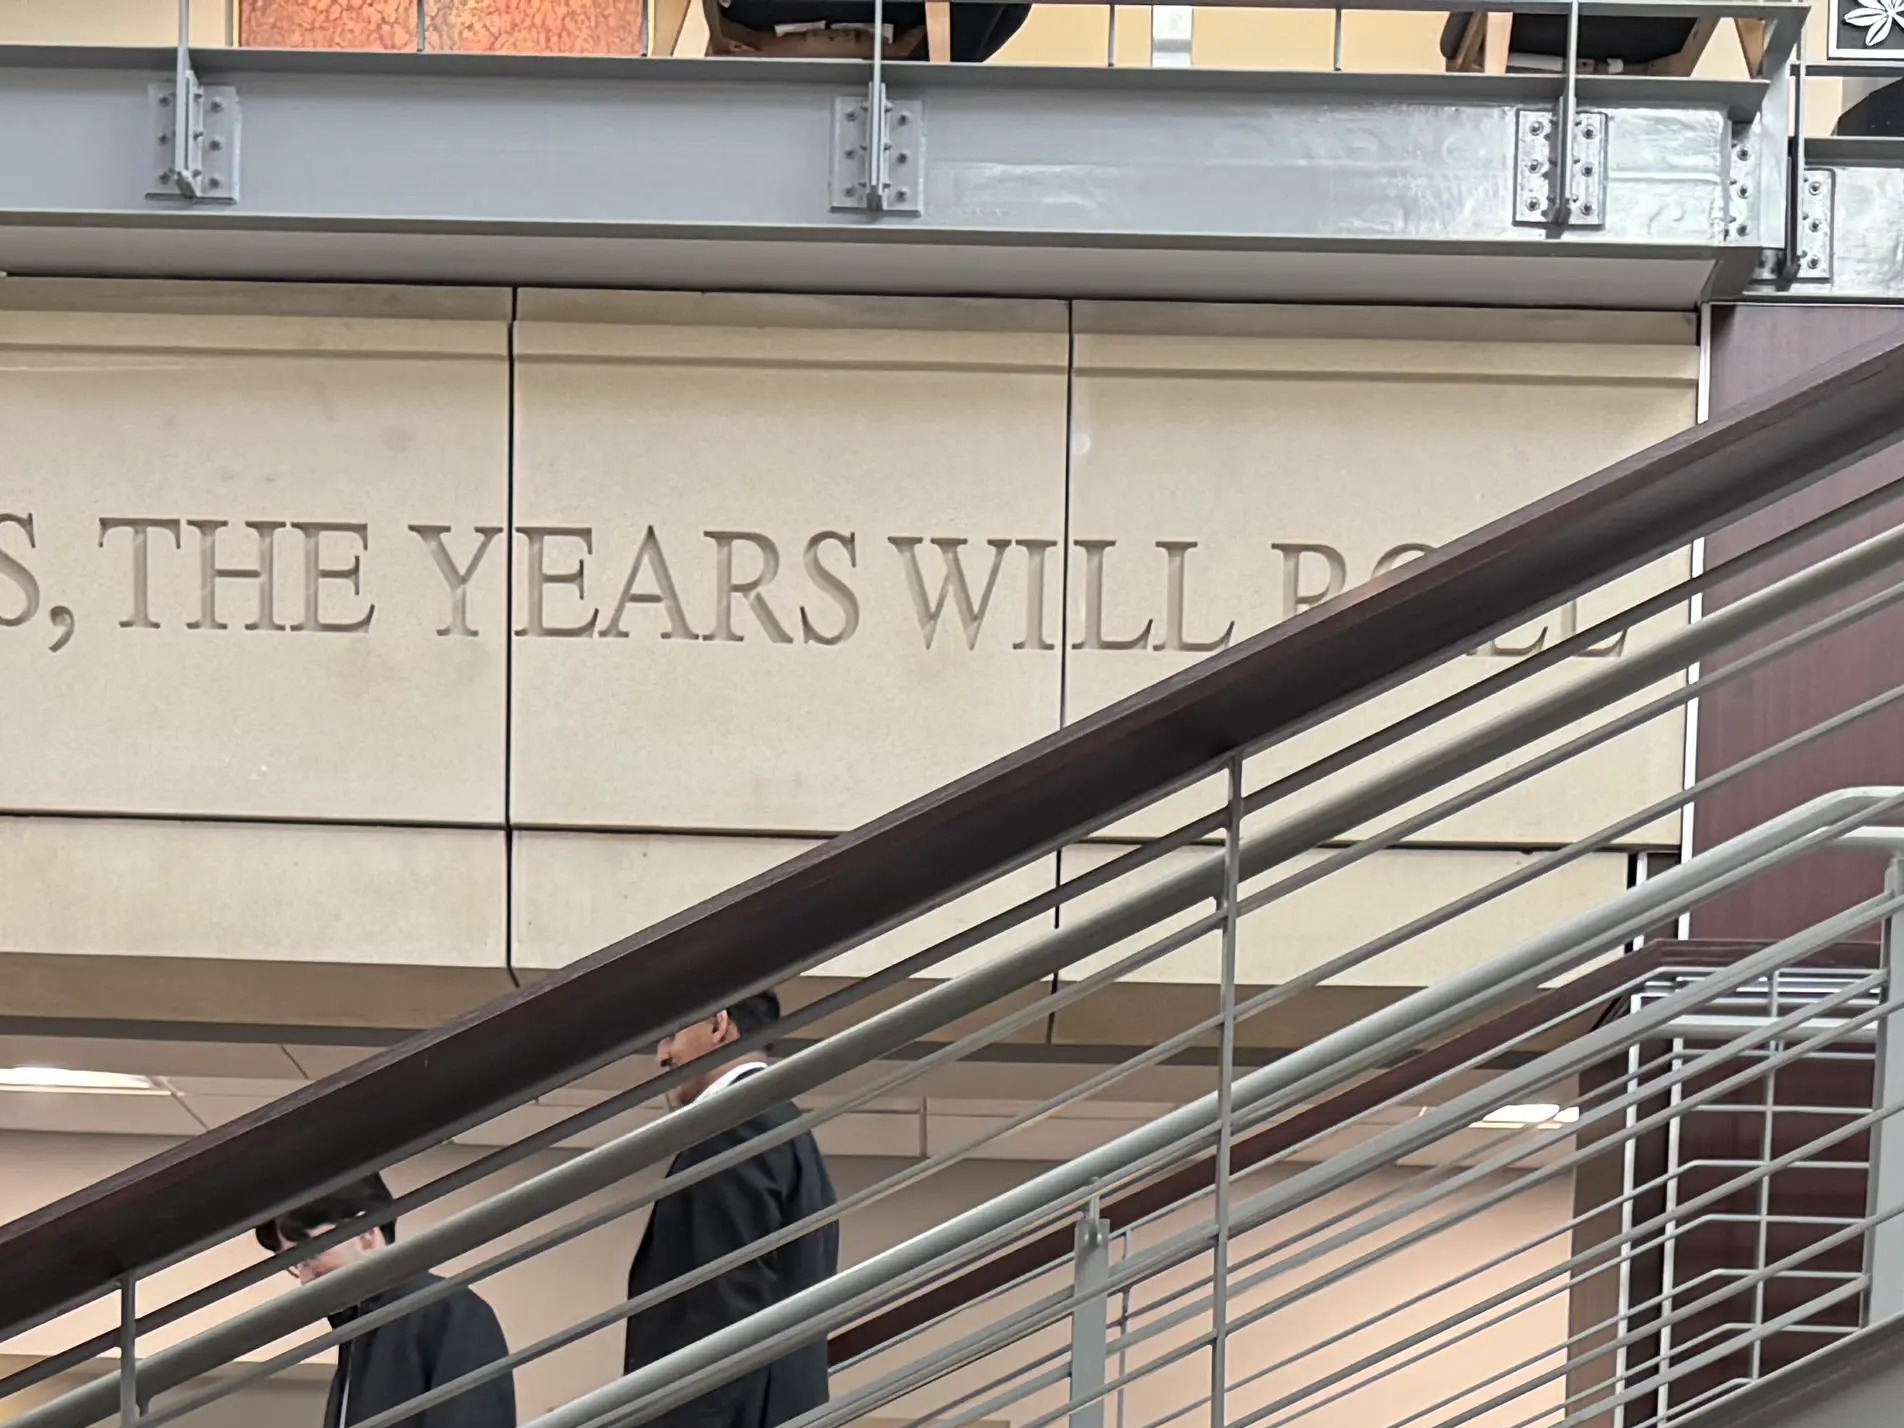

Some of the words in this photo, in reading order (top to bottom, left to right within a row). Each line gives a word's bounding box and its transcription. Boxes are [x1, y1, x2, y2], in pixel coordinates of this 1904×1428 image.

[96, 516, 375, 635] THE
[407, 523, 862, 648] YEARS
[886, 535, 1235, 653] WILL
[1271, 542, 1628, 658] RL
